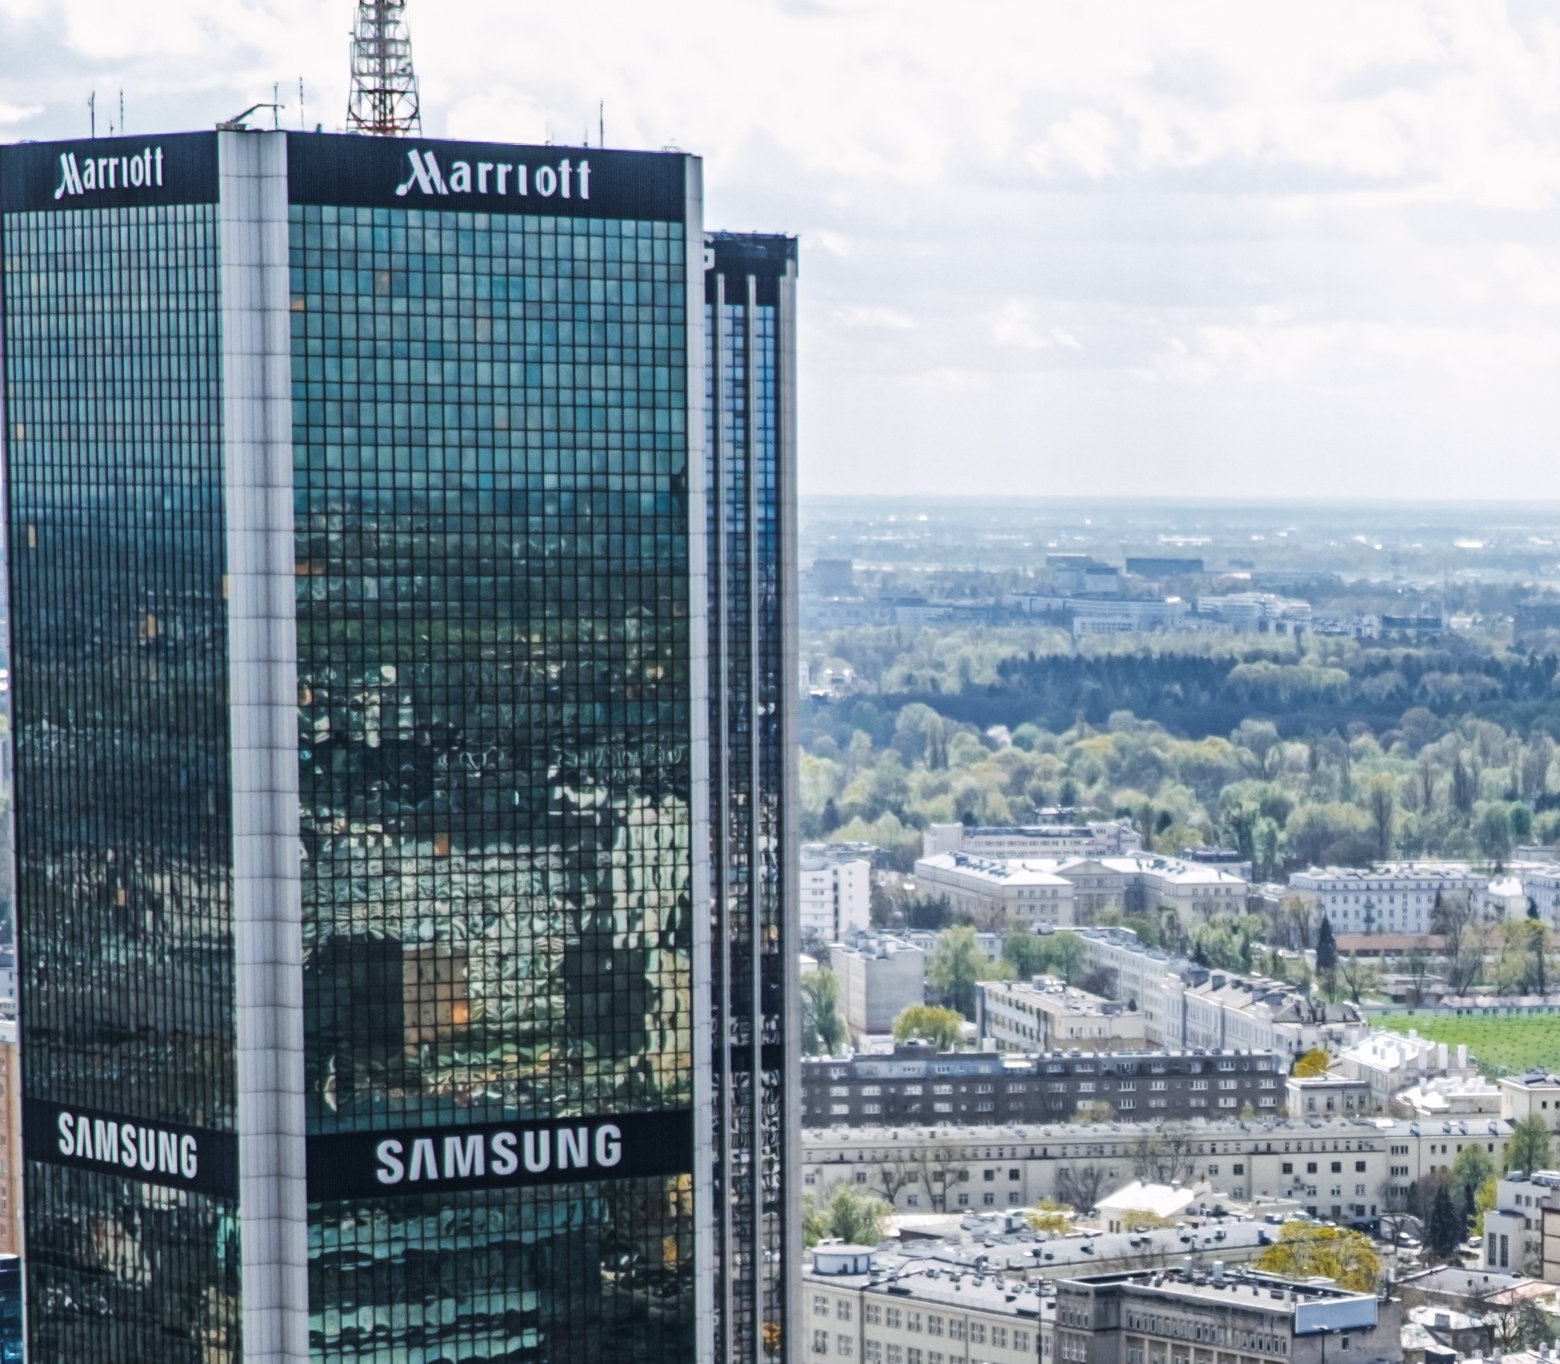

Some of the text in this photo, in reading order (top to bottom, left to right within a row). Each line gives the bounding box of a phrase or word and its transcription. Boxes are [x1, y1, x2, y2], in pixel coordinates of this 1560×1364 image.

[54, 147, 164, 200] Marriott
[395, 149, 592, 200] Marriott
[58, 1111, 198, 1179] SAMSUNG
[376, 1124, 622, 1185] SAMSUNG
